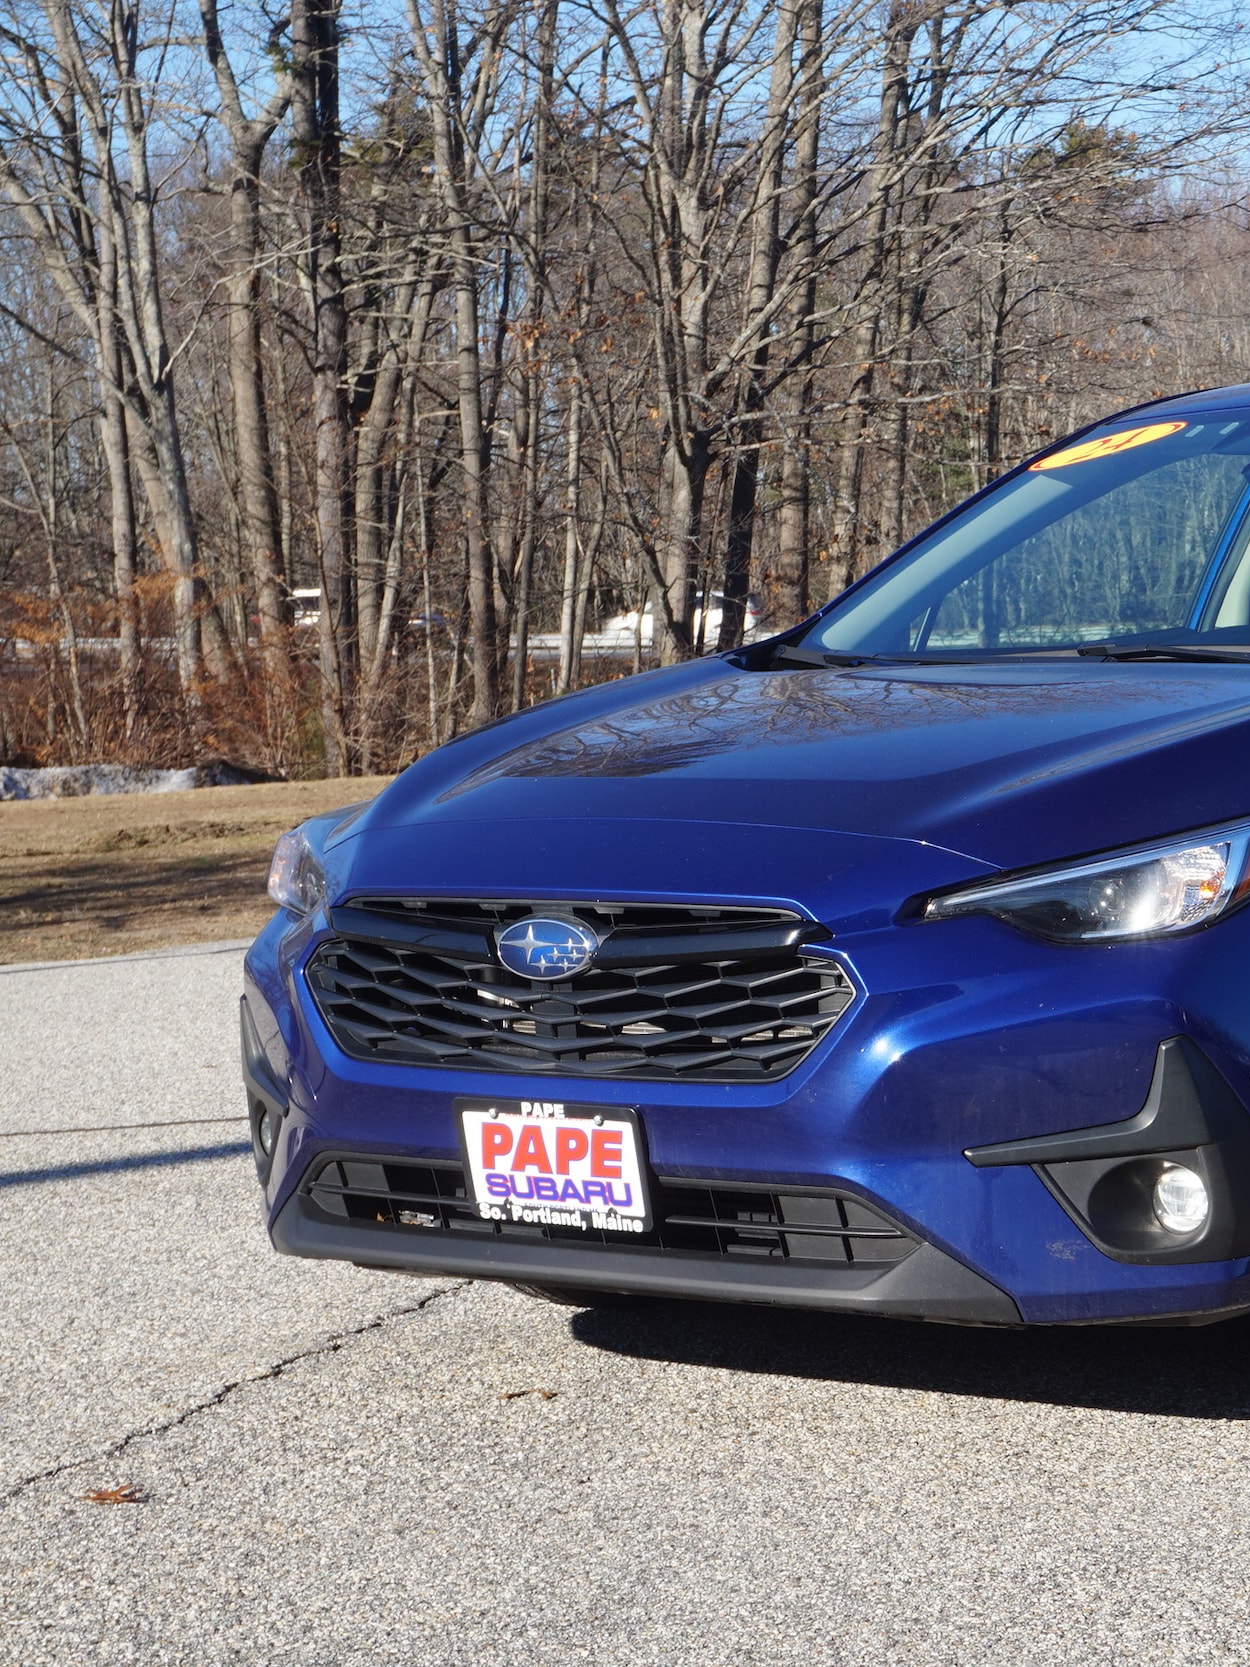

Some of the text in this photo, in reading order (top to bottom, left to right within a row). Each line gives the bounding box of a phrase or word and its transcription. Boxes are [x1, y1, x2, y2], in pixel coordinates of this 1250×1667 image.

[521, 1102, 565, 1119] PAPE
[481, 1122, 623, 1179] PAPE
[485, 1173, 633, 1207] SUBARU
[479, 1204, 644, 1233] So. Portland, Maine
